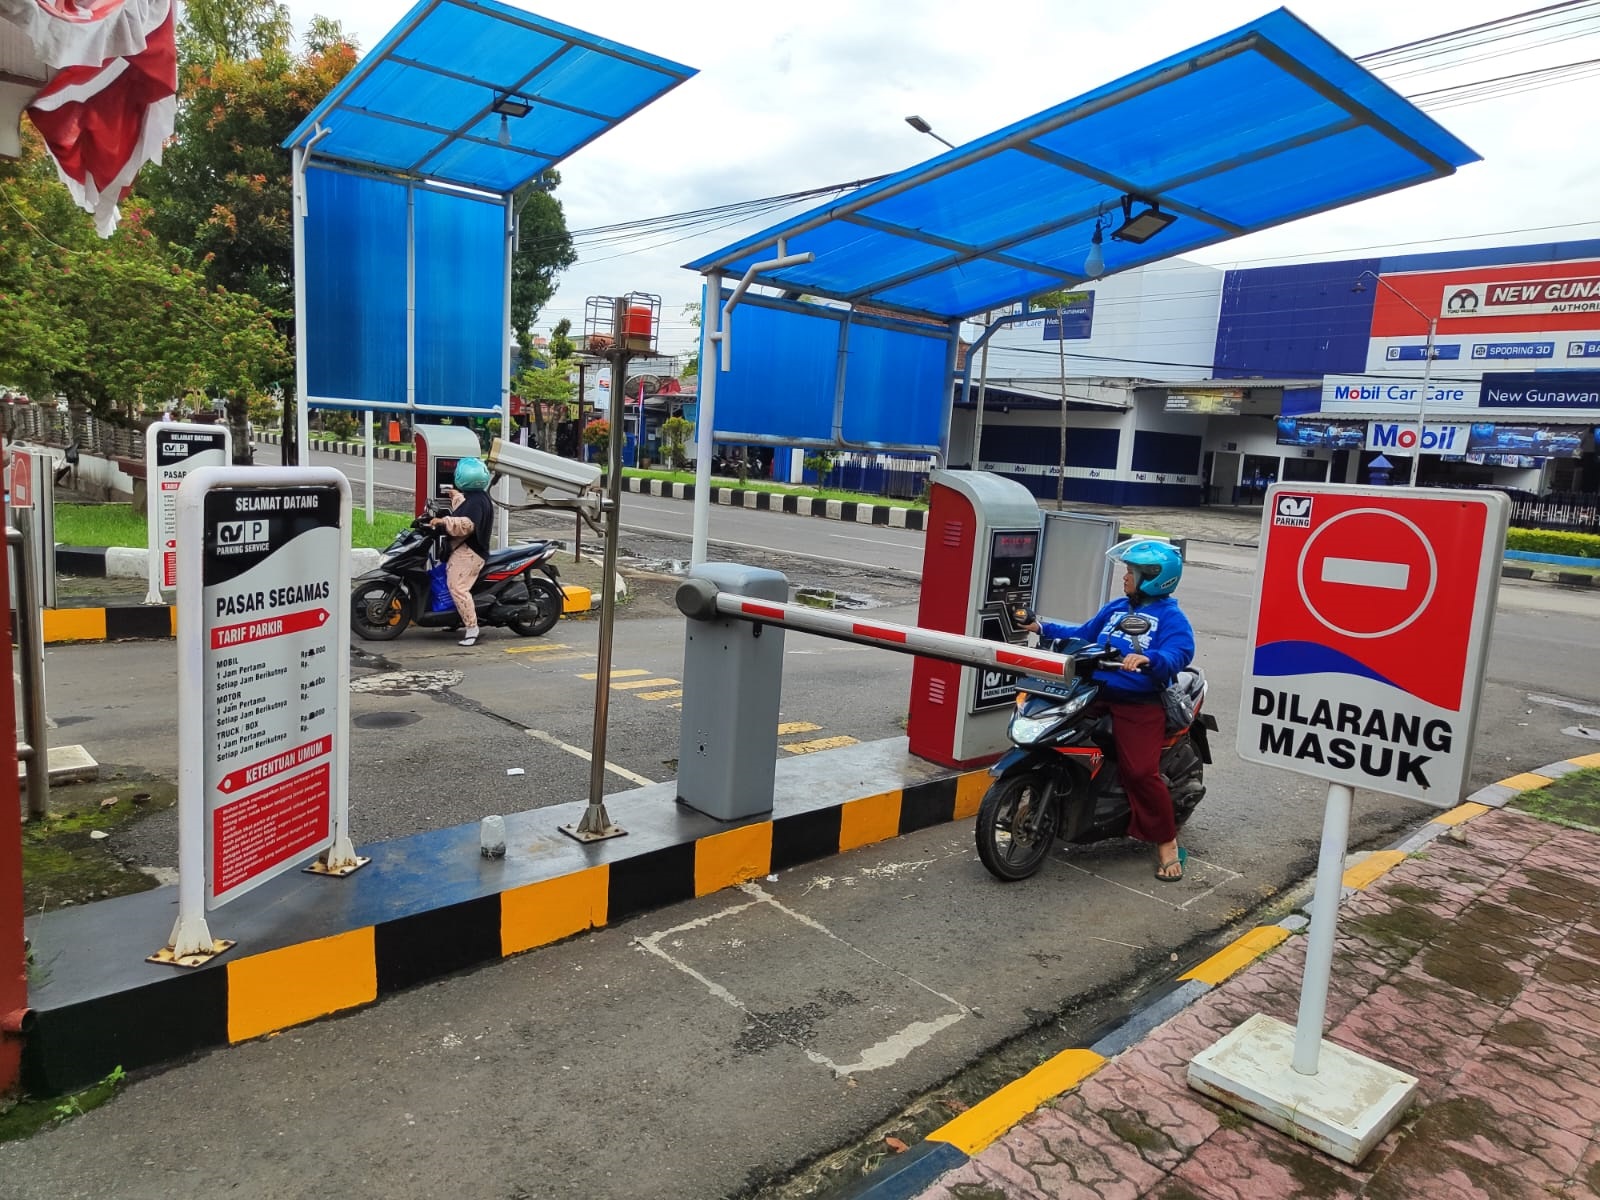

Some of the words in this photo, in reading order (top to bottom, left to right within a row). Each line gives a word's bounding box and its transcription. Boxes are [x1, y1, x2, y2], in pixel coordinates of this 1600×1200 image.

[1492, 285, 1542, 303] NEW
[1489, 346, 1534, 355] SPOORING
[1535, 345, 1551, 354] 3D
[1335, 386, 1380, 400] Mobil
[1387, 386, 1418, 400] Car
[1425, 386, 1464, 400] Care
[1487, 389, 1522, 401] New
[1526, 389, 1599, 402] Gunawan
[1373, 424, 1456, 449] Mobil
[235, 496, 281, 511] SELAMAT
[284, 495, 319, 509] DATANG
[252, 522, 262, 541] P
[1275, 517, 1310, 527] PARKING
[217, 545, 243, 555] PARKING
[245, 542, 269, 553] SERVICE
[216, 591, 265, 617] PASAR
[268, 581, 329, 608] SEGAMAS
[217, 626, 247, 645] TARIF
[249, 619, 283, 639] PARKIR
[216, 657, 239, 669] MOBIL
[217, 672, 221, 680] 1
[223, 669, 238, 679] Jam
[240, 662, 266, 674] Pertama
[216, 679, 238, 691] Setiap
[240, 675, 254, 685] Jam
[255, 666, 288, 681] Berikutnya
[216, 691, 241, 705] MOTOR
[223, 705, 238, 714] Jam
[240, 697, 266, 709] Pertama
[216, 716, 239, 727] Setiap
[240, 711, 254, 720] Jam
[255, 699, 288, 715] Berikutnya
[1251, 686, 1453, 754] DILARANG
[216, 725, 240, 740] TRUCK
[245, 720, 259, 732] BOX
[223, 739, 238, 749] Jam
[240, 730, 266, 744] Pertama
[216, 750, 239, 762] Setiap
[240, 744, 254, 754] Jam
[255, 732, 288, 749] Berikutnya
[1258, 722, 1432, 788] MASUK
[245, 752, 296, 783] KETENTUAN
[298, 741, 323, 762] UMUM
